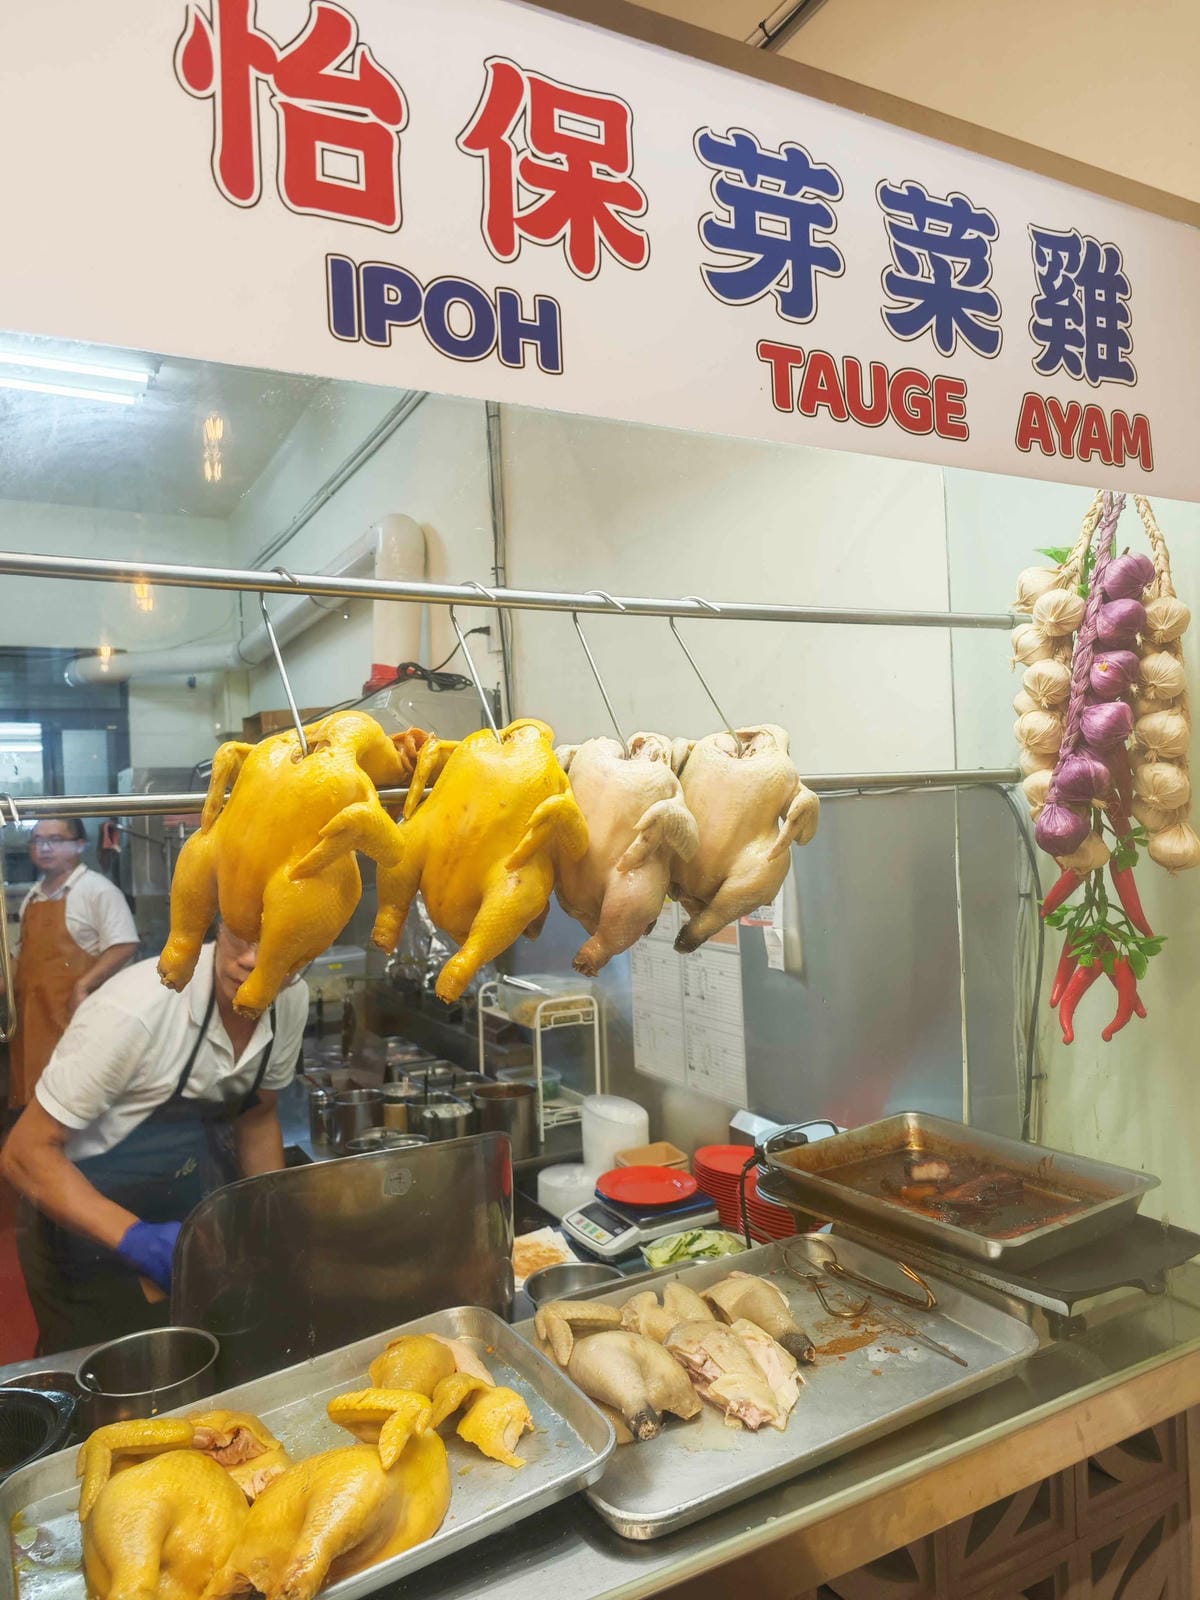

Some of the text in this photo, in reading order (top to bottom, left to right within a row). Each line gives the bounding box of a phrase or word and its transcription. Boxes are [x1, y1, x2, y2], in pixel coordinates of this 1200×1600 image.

[326, 253, 1154, 472] IPOH TAUGE AYAM
